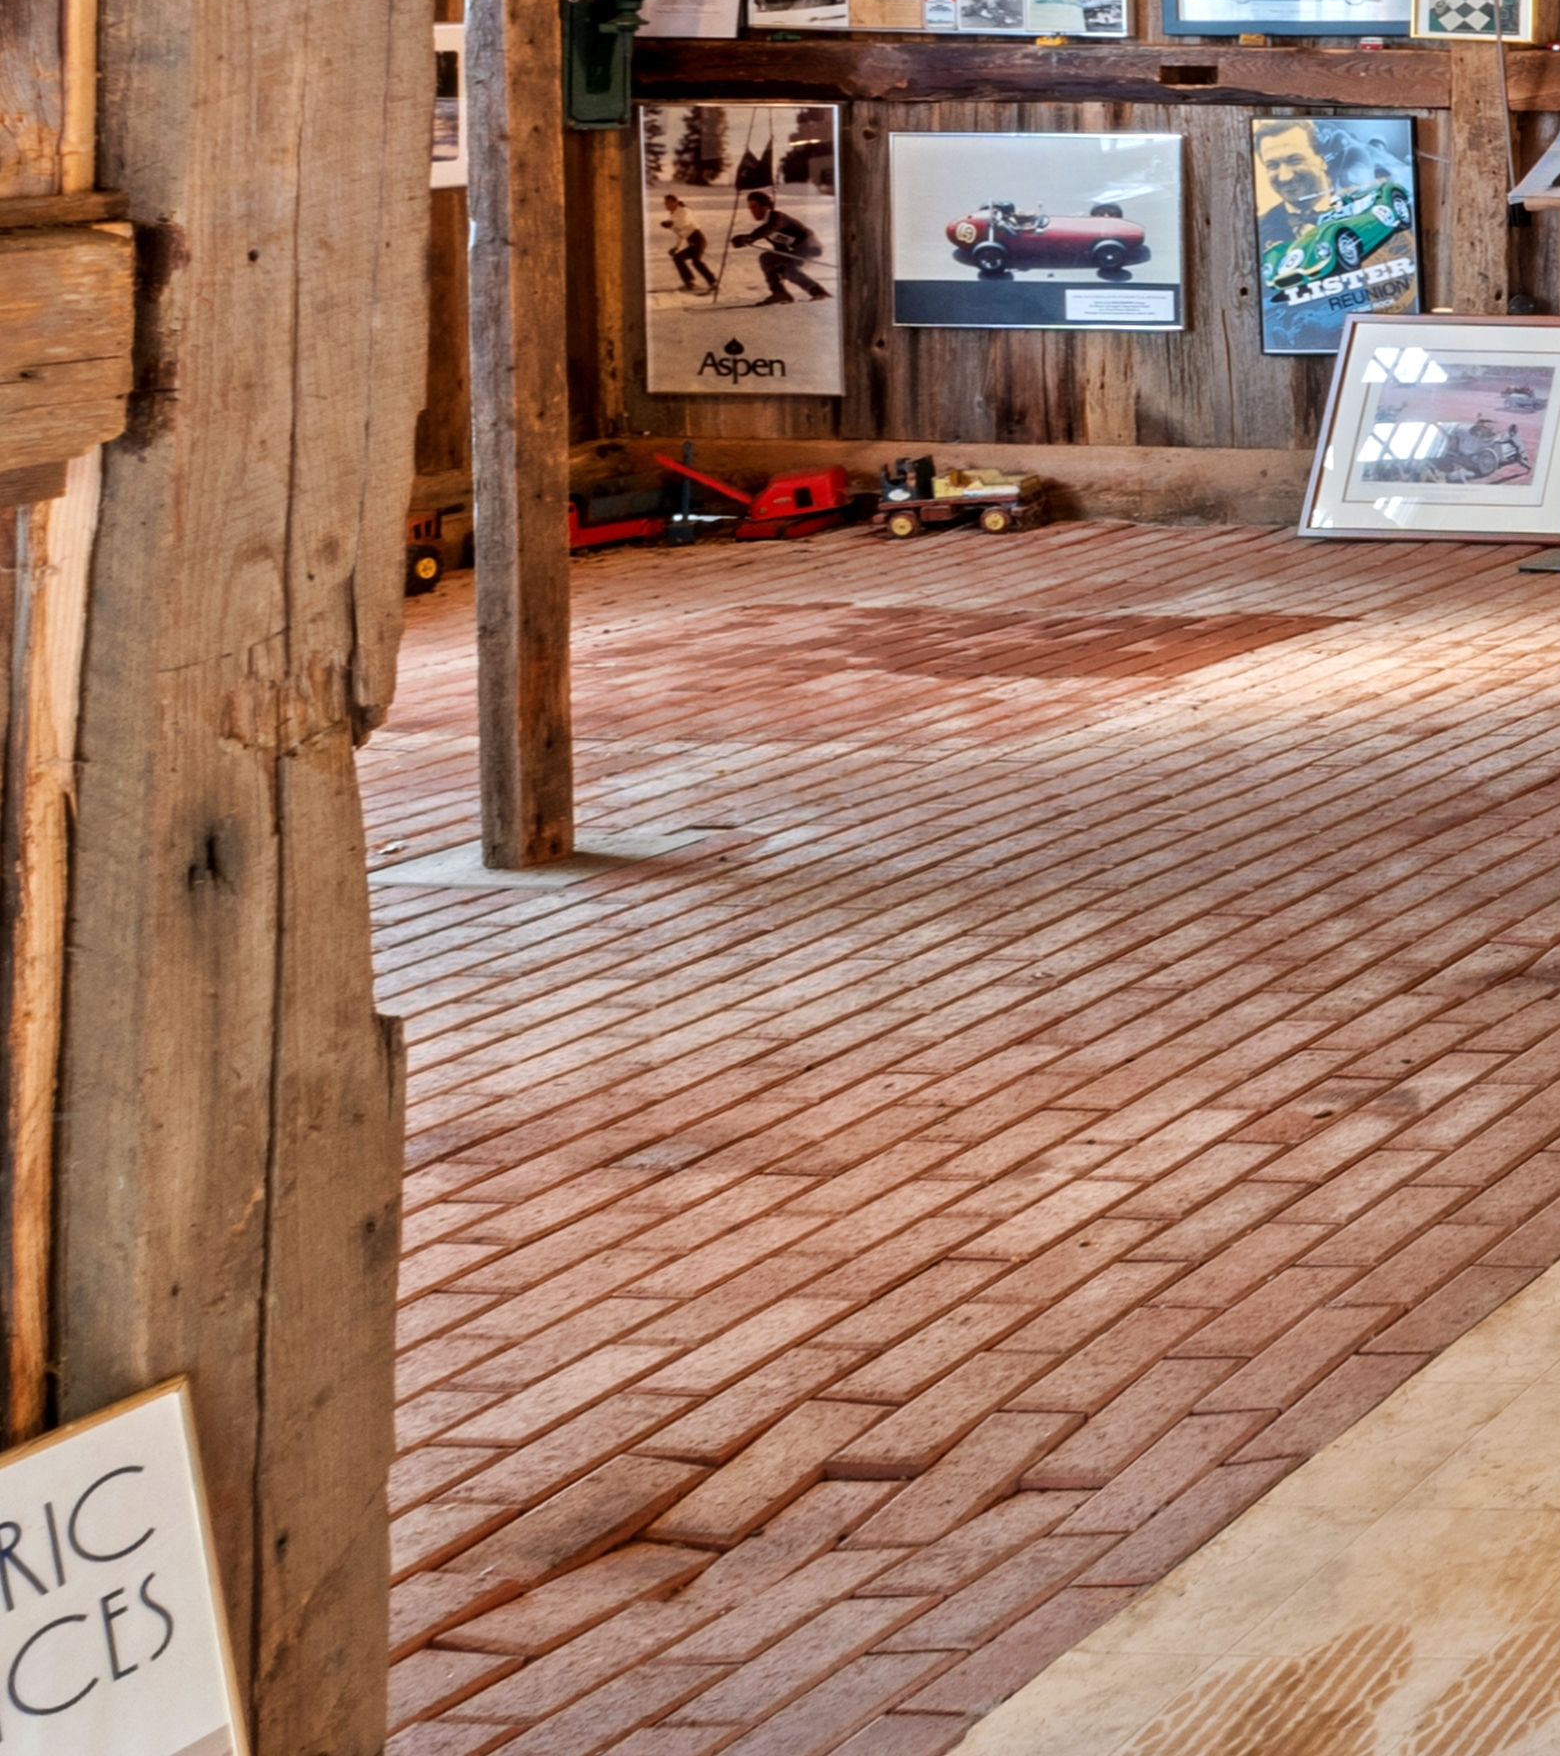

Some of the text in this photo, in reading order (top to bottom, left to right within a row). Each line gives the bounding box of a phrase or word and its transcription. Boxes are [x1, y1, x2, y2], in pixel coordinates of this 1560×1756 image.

[1284, 257, 1416, 306] LISTER
[1328, 275, 1411, 312] REUNION
[697, 351, 786, 386] Aspen
